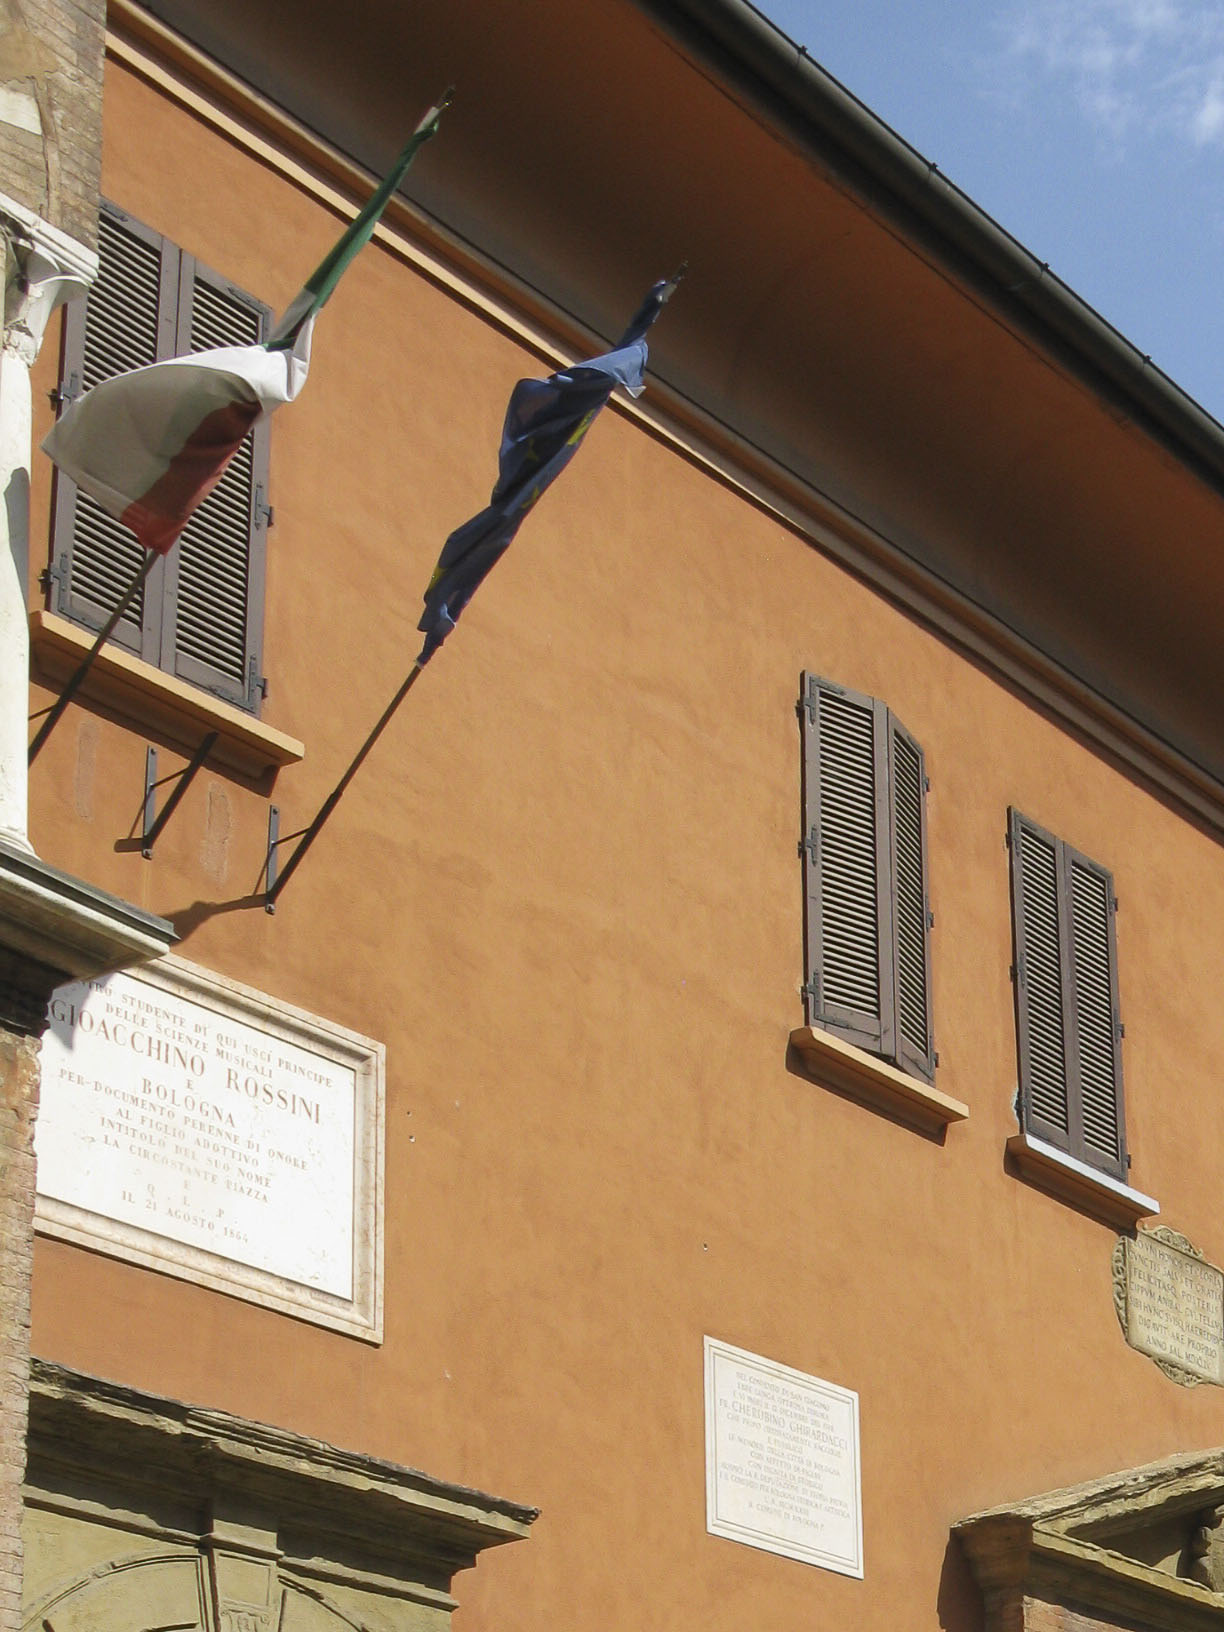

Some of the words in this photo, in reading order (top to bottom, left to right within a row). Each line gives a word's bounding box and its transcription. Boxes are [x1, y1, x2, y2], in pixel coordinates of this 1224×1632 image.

[50, 996, 204, 1079] GIOACCHINO
[226, 1067, 320, 1125] ROSSINI
[106, 1002, 147, 1028] DELLE
[155, 1022, 208, 1053] SCIENZE
[215, 1047, 272, 1079] MUSICALI
[121, 992, 185, 1028] STUDENTE
[216, 1032, 236, 1052] QUI
[278, 1057, 332, 1089] PRINCIPE
[143, 1077, 235, 1128] BOLOGNA
[186, 1078, 193, 1090] E
[116, 1105, 131, 1121] AL
[141, 1114, 185, 1141] FIGLIO
[194, 1135, 258, 1168] ADOTTIVO
[184, 1115, 239, 1145] PERENNE
[247, 1139, 259, 1153] DI
[267, 1147, 307, 1171] ONORE
[104, 1133, 119, 1149] LA
[129, 1143, 217, 1185] CIRCOSTANTE
[226, 1178, 267, 1203] PIAZZA
[175, 1143, 197, 1161] DEL
[207, 1155, 230, 1173] SUO
[238, 1167, 271, 1188] NOME
[145, 1198, 156, 1211] 21
[167, 1205, 214, 1231] AGOSTO
[731, 1399, 785, 1429] CHERUBINO
[789, 1420, 847, 1451] GHIRARDACCI
